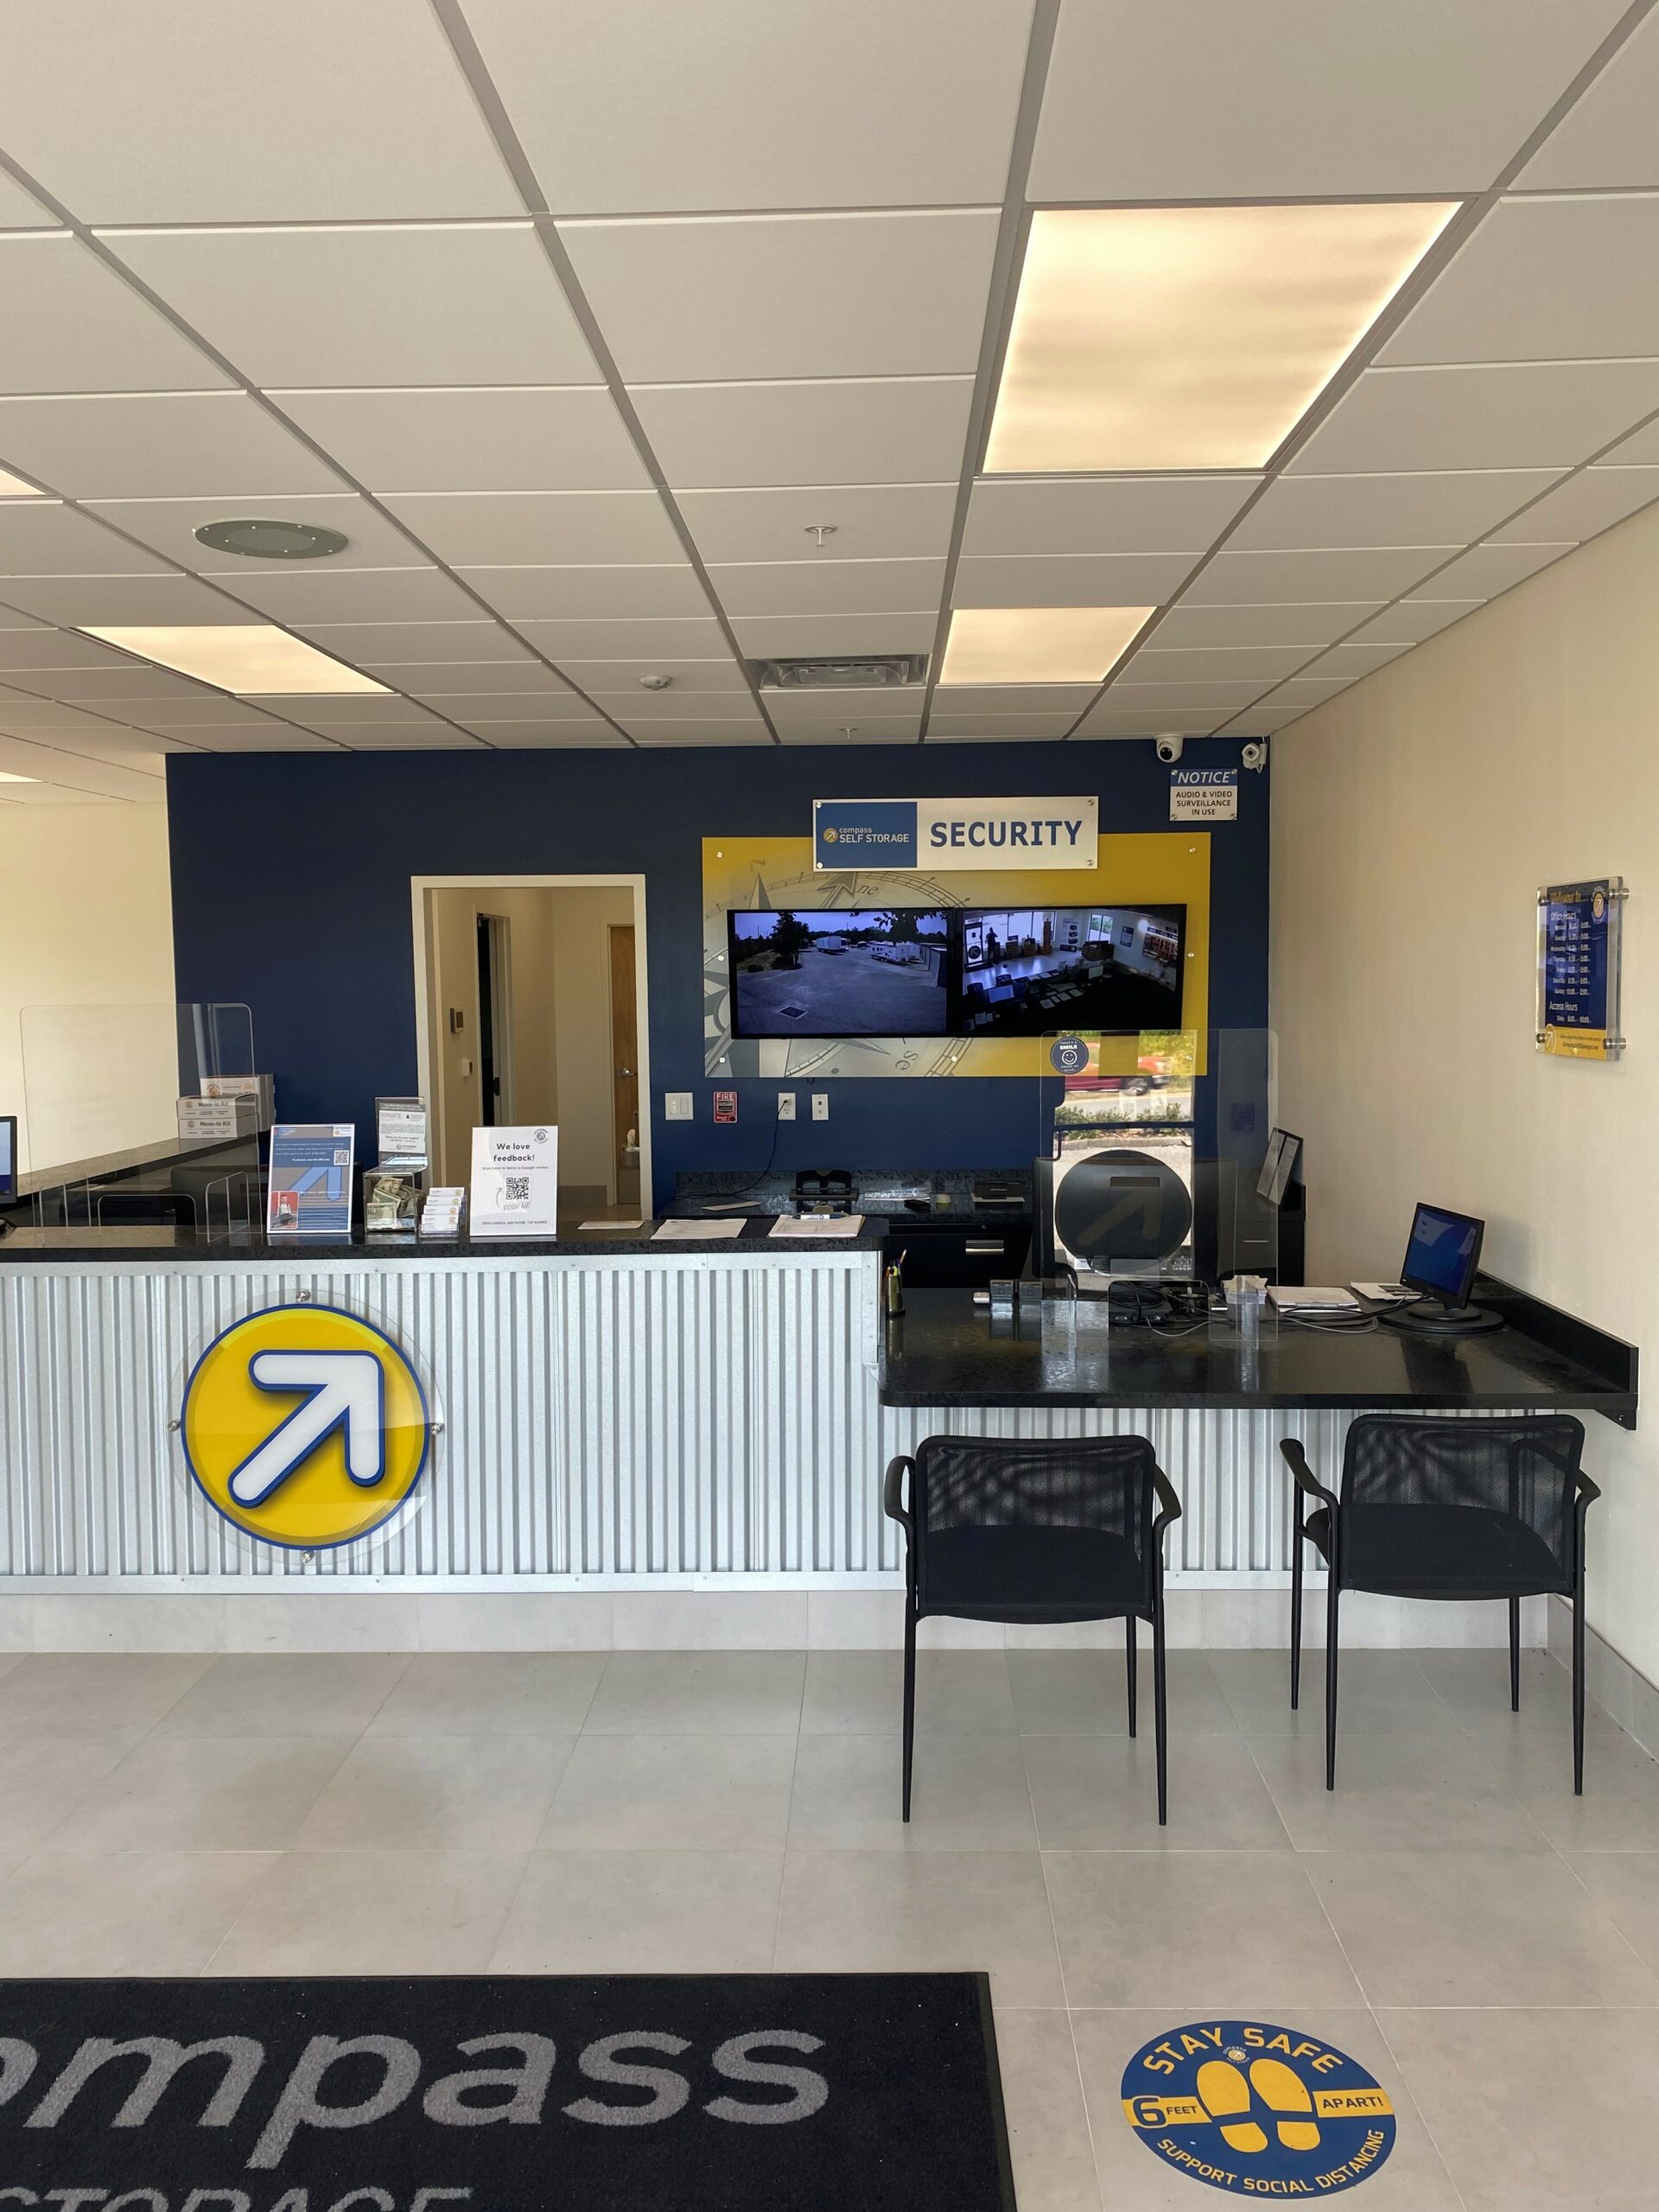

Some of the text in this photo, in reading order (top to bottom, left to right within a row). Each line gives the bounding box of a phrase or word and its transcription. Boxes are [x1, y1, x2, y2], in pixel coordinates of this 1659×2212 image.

[1178, 772, 1230, 784] NOTICE
[840, 834, 910, 843] SELF STORAGE
[930, 821, 1083, 848] SECURITY
[1565, 1001, 1578, 1012] Hours
[493, 1154, 535, 1162] feedback!
[1142, 2026, 1344, 2075] STAY SAFE
[1132, 2095, 1384, 2128] 6 FEET APART!
[1156, 2129, 1385, 2193] SUPPORT SOCIAL DISTANCING
